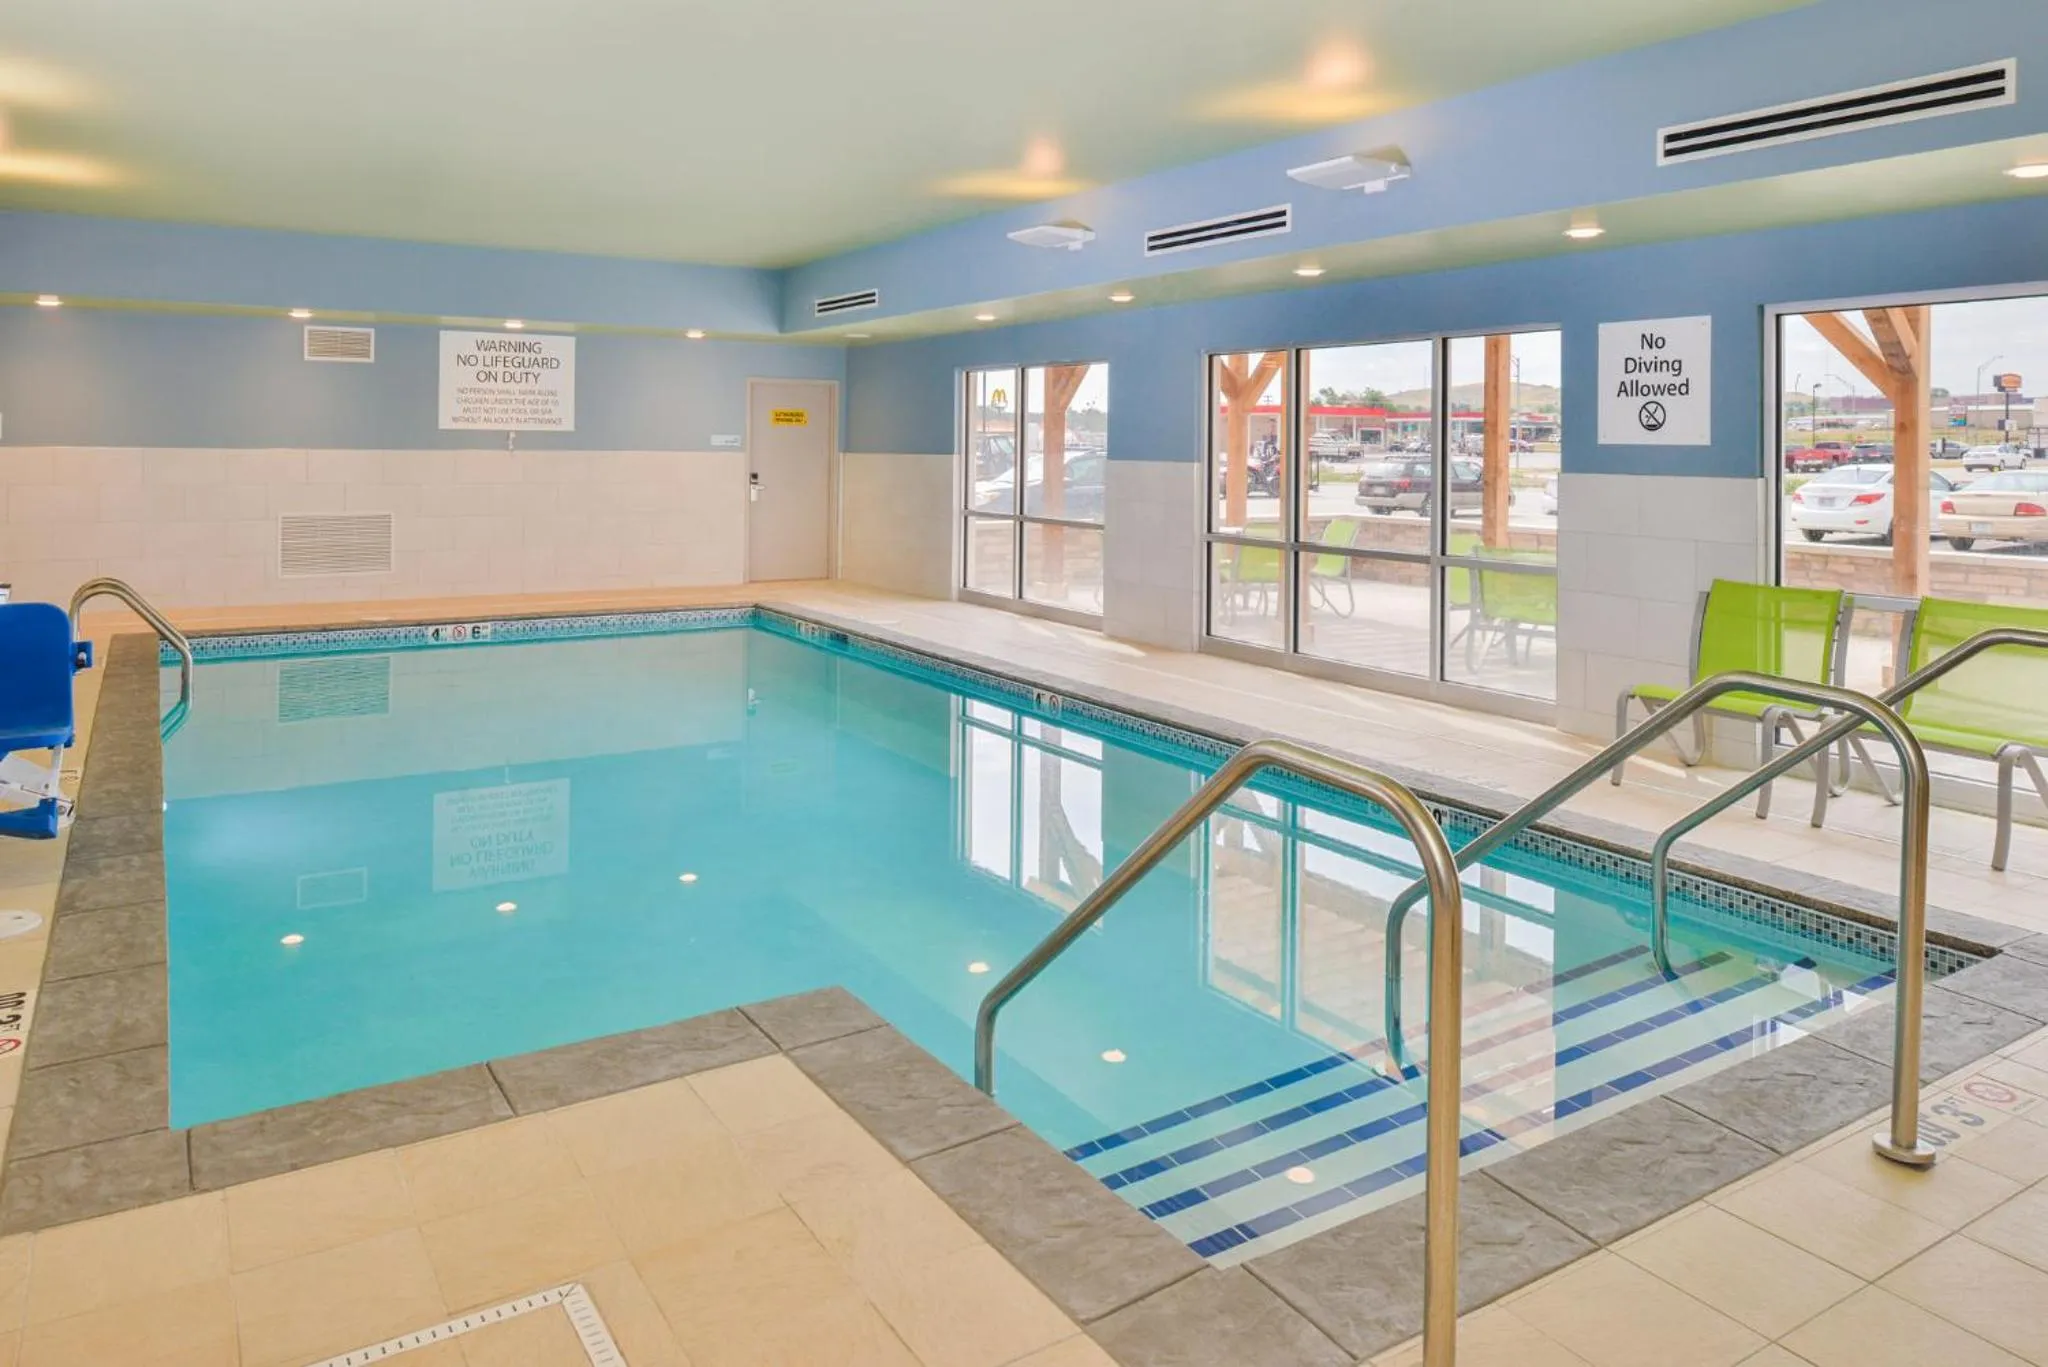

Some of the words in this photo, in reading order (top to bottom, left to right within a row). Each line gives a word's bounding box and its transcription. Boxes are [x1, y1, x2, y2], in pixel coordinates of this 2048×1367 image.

[475, 339, 542, 355] WARNING
[1641, 333, 1666, 350] No
[457, 354, 478, 367] NO
[483, 355, 560, 369] LIFEGUARD
[1624, 356, 1682, 377] Diving
[476, 370, 497, 383] ON
[502, 371, 541, 384] DUTY
[1617, 378, 1689, 398] Allowed
